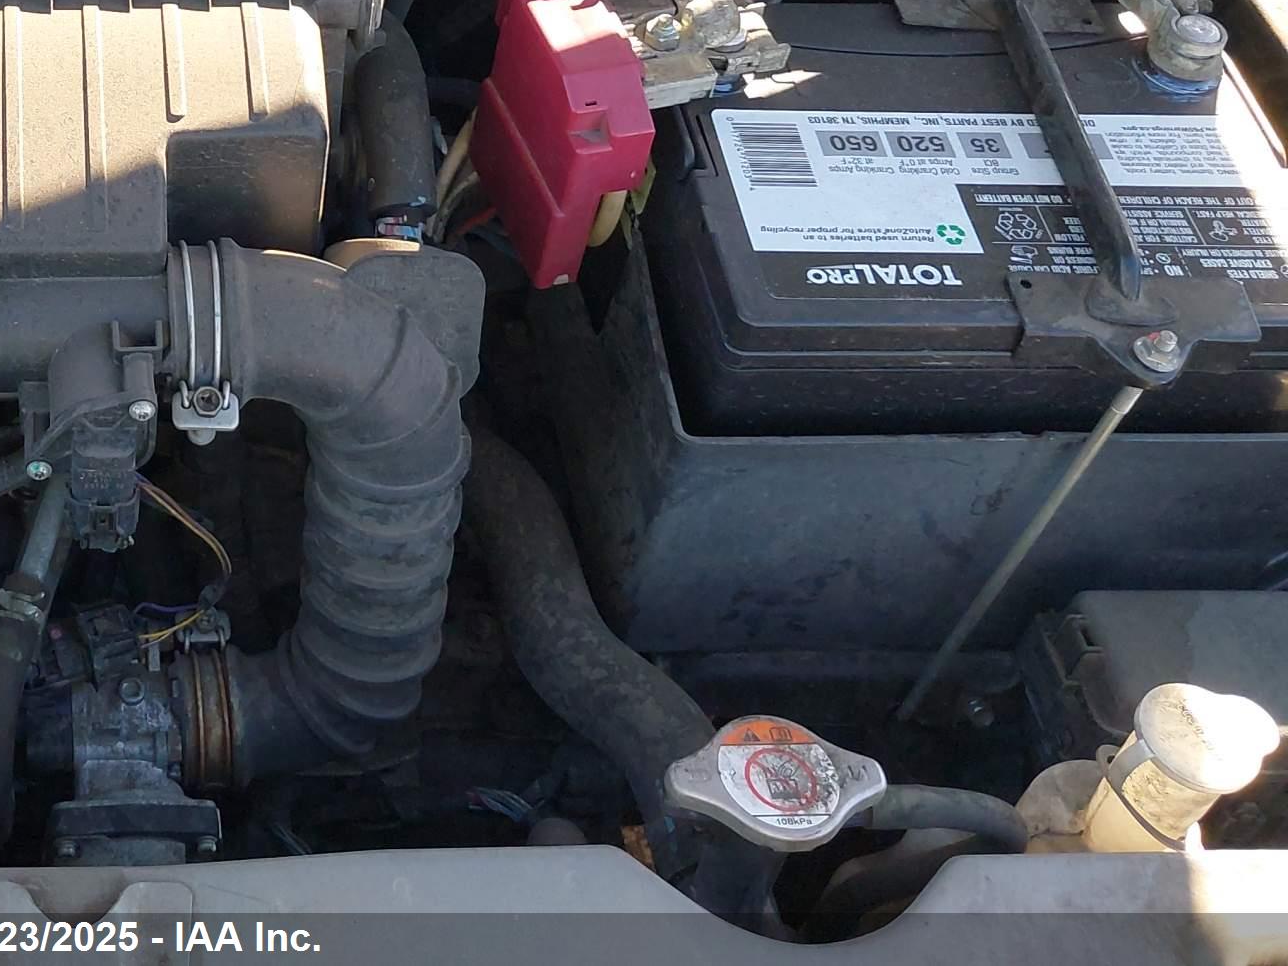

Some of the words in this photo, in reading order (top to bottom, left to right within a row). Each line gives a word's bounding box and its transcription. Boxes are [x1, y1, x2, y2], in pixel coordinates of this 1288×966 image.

[807, 116, 839, 124] 38103
[841, 116, 856, 124] TN
[856, 116, 910, 125] MEMPHIS,
[940, 116, 978, 126] PARTS,
[981, 118, 1007, 126] BEST
[829, 135, 878, 152] 650
[897, 136, 945, 152] 520
[970, 138, 1001, 153] 35
[855, 166, 895, 174] Cranking
[898, 166, 938, 175] Cranking
[940, 167, 960, 176] Cold
[971, 167, 992, 175] Size
[992, 167, 1020, 175] Group
[1173, 196, 1203, 205] REACH
[1203, 196, 1221, 205] THE
[1164, 265, 1184, 276] NO
[775, 817, 814, 826] 108kPa
